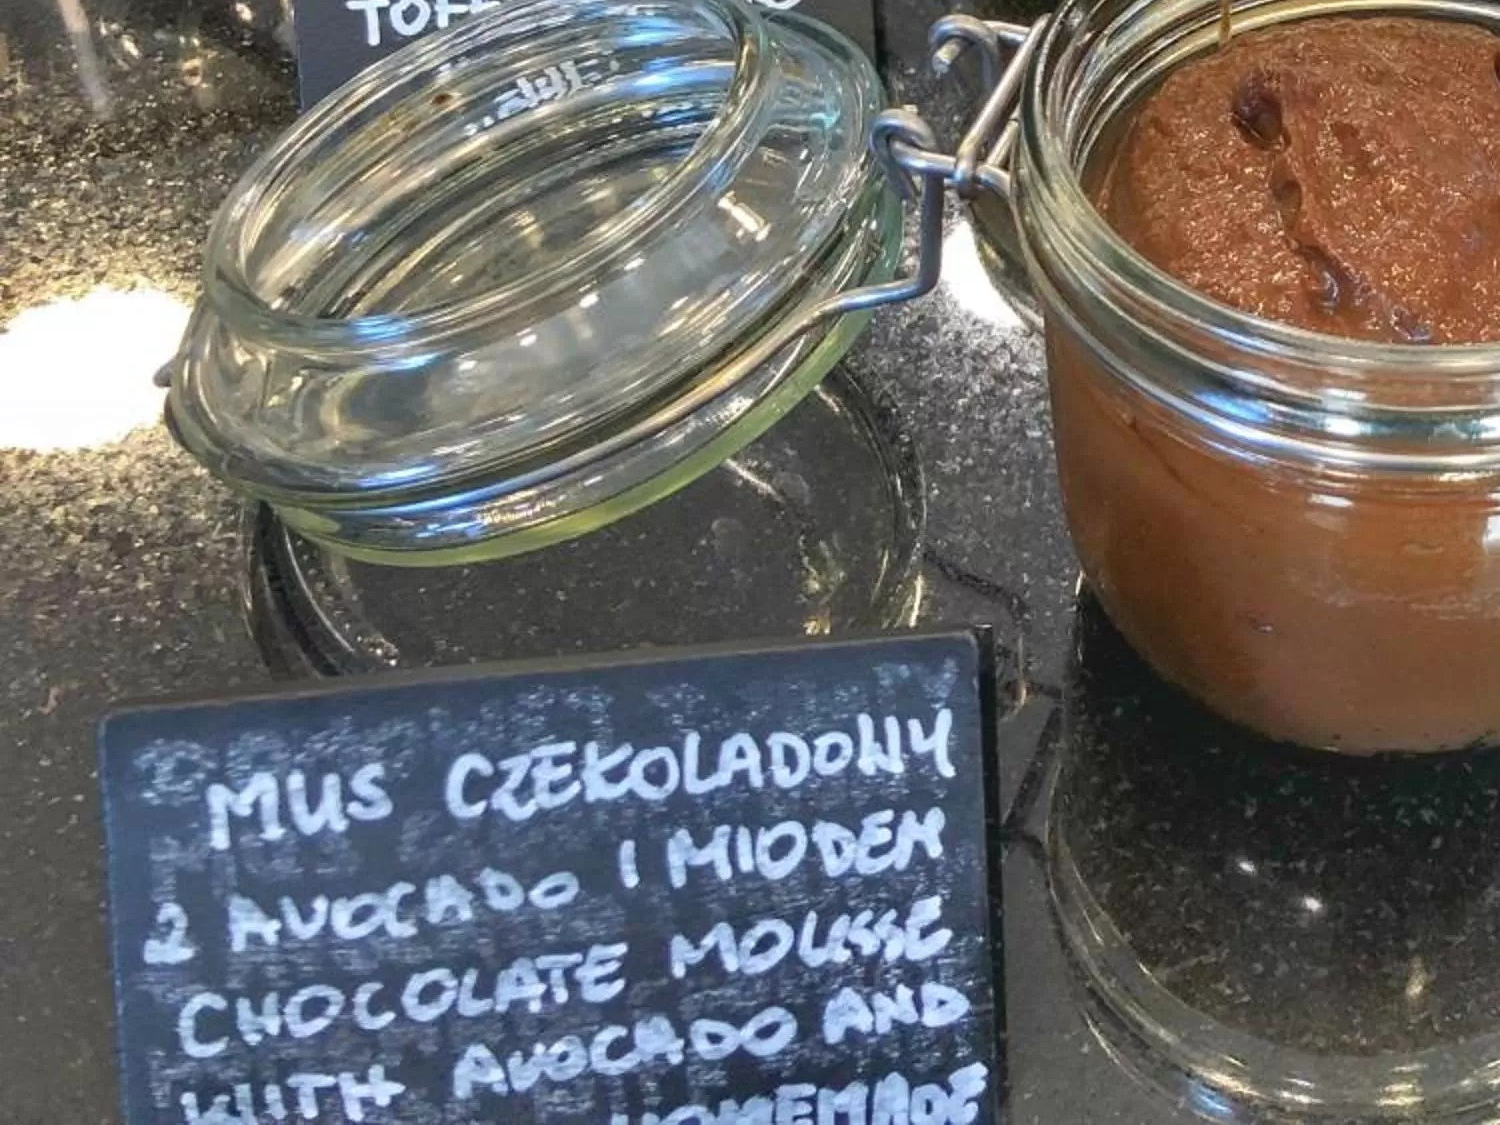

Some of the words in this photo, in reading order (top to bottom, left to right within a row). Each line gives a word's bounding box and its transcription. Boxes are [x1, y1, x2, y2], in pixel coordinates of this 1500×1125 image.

[206, 763, 393, 850] MUS
[444, 708, 957, 821] CZEKOLADOWY
[228, 868, 579, 952] AVOCADO
[667, 806, 946, 889] MIODEM
[177, 943, 627, 1058] CHOCOLATE
[670, 894, 953, 979] MOUSSE
[180, 1064, 406, 1125] WITH
[452, 1006, 798, 1098] AVOCADO
[823, 981, 970, 1044] AND
